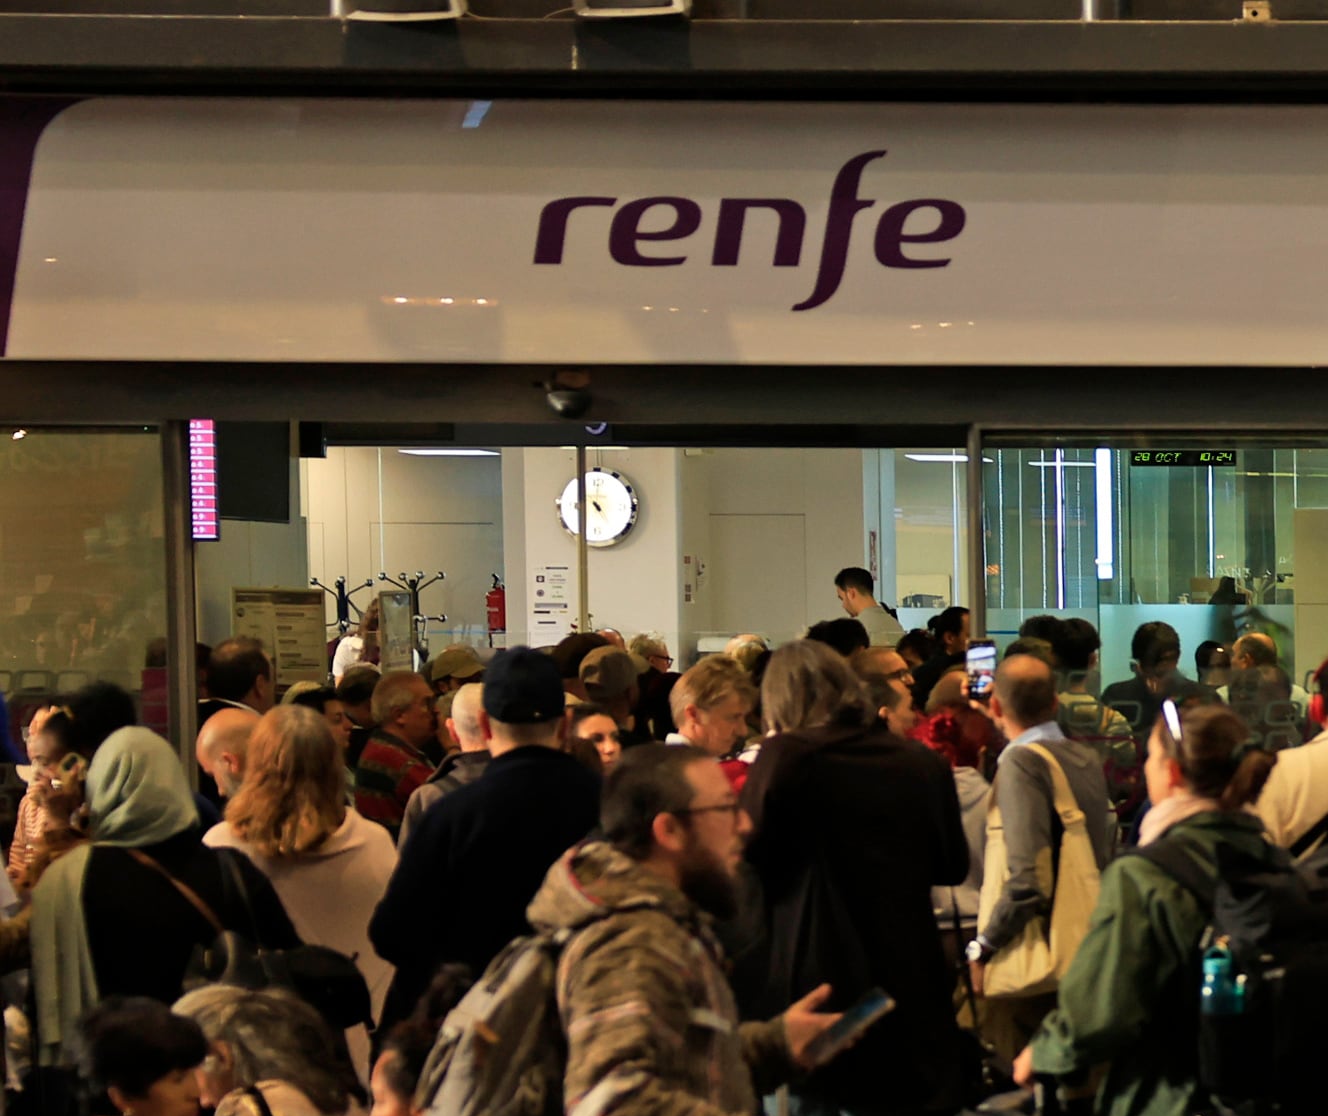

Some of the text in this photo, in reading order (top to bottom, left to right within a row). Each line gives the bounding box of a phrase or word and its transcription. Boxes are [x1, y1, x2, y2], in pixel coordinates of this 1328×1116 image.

[533, 149, 966, 311] renfe
[1155, 452, 1182, 463] OCT
[1199, 452, 1233, 462] 10:24
